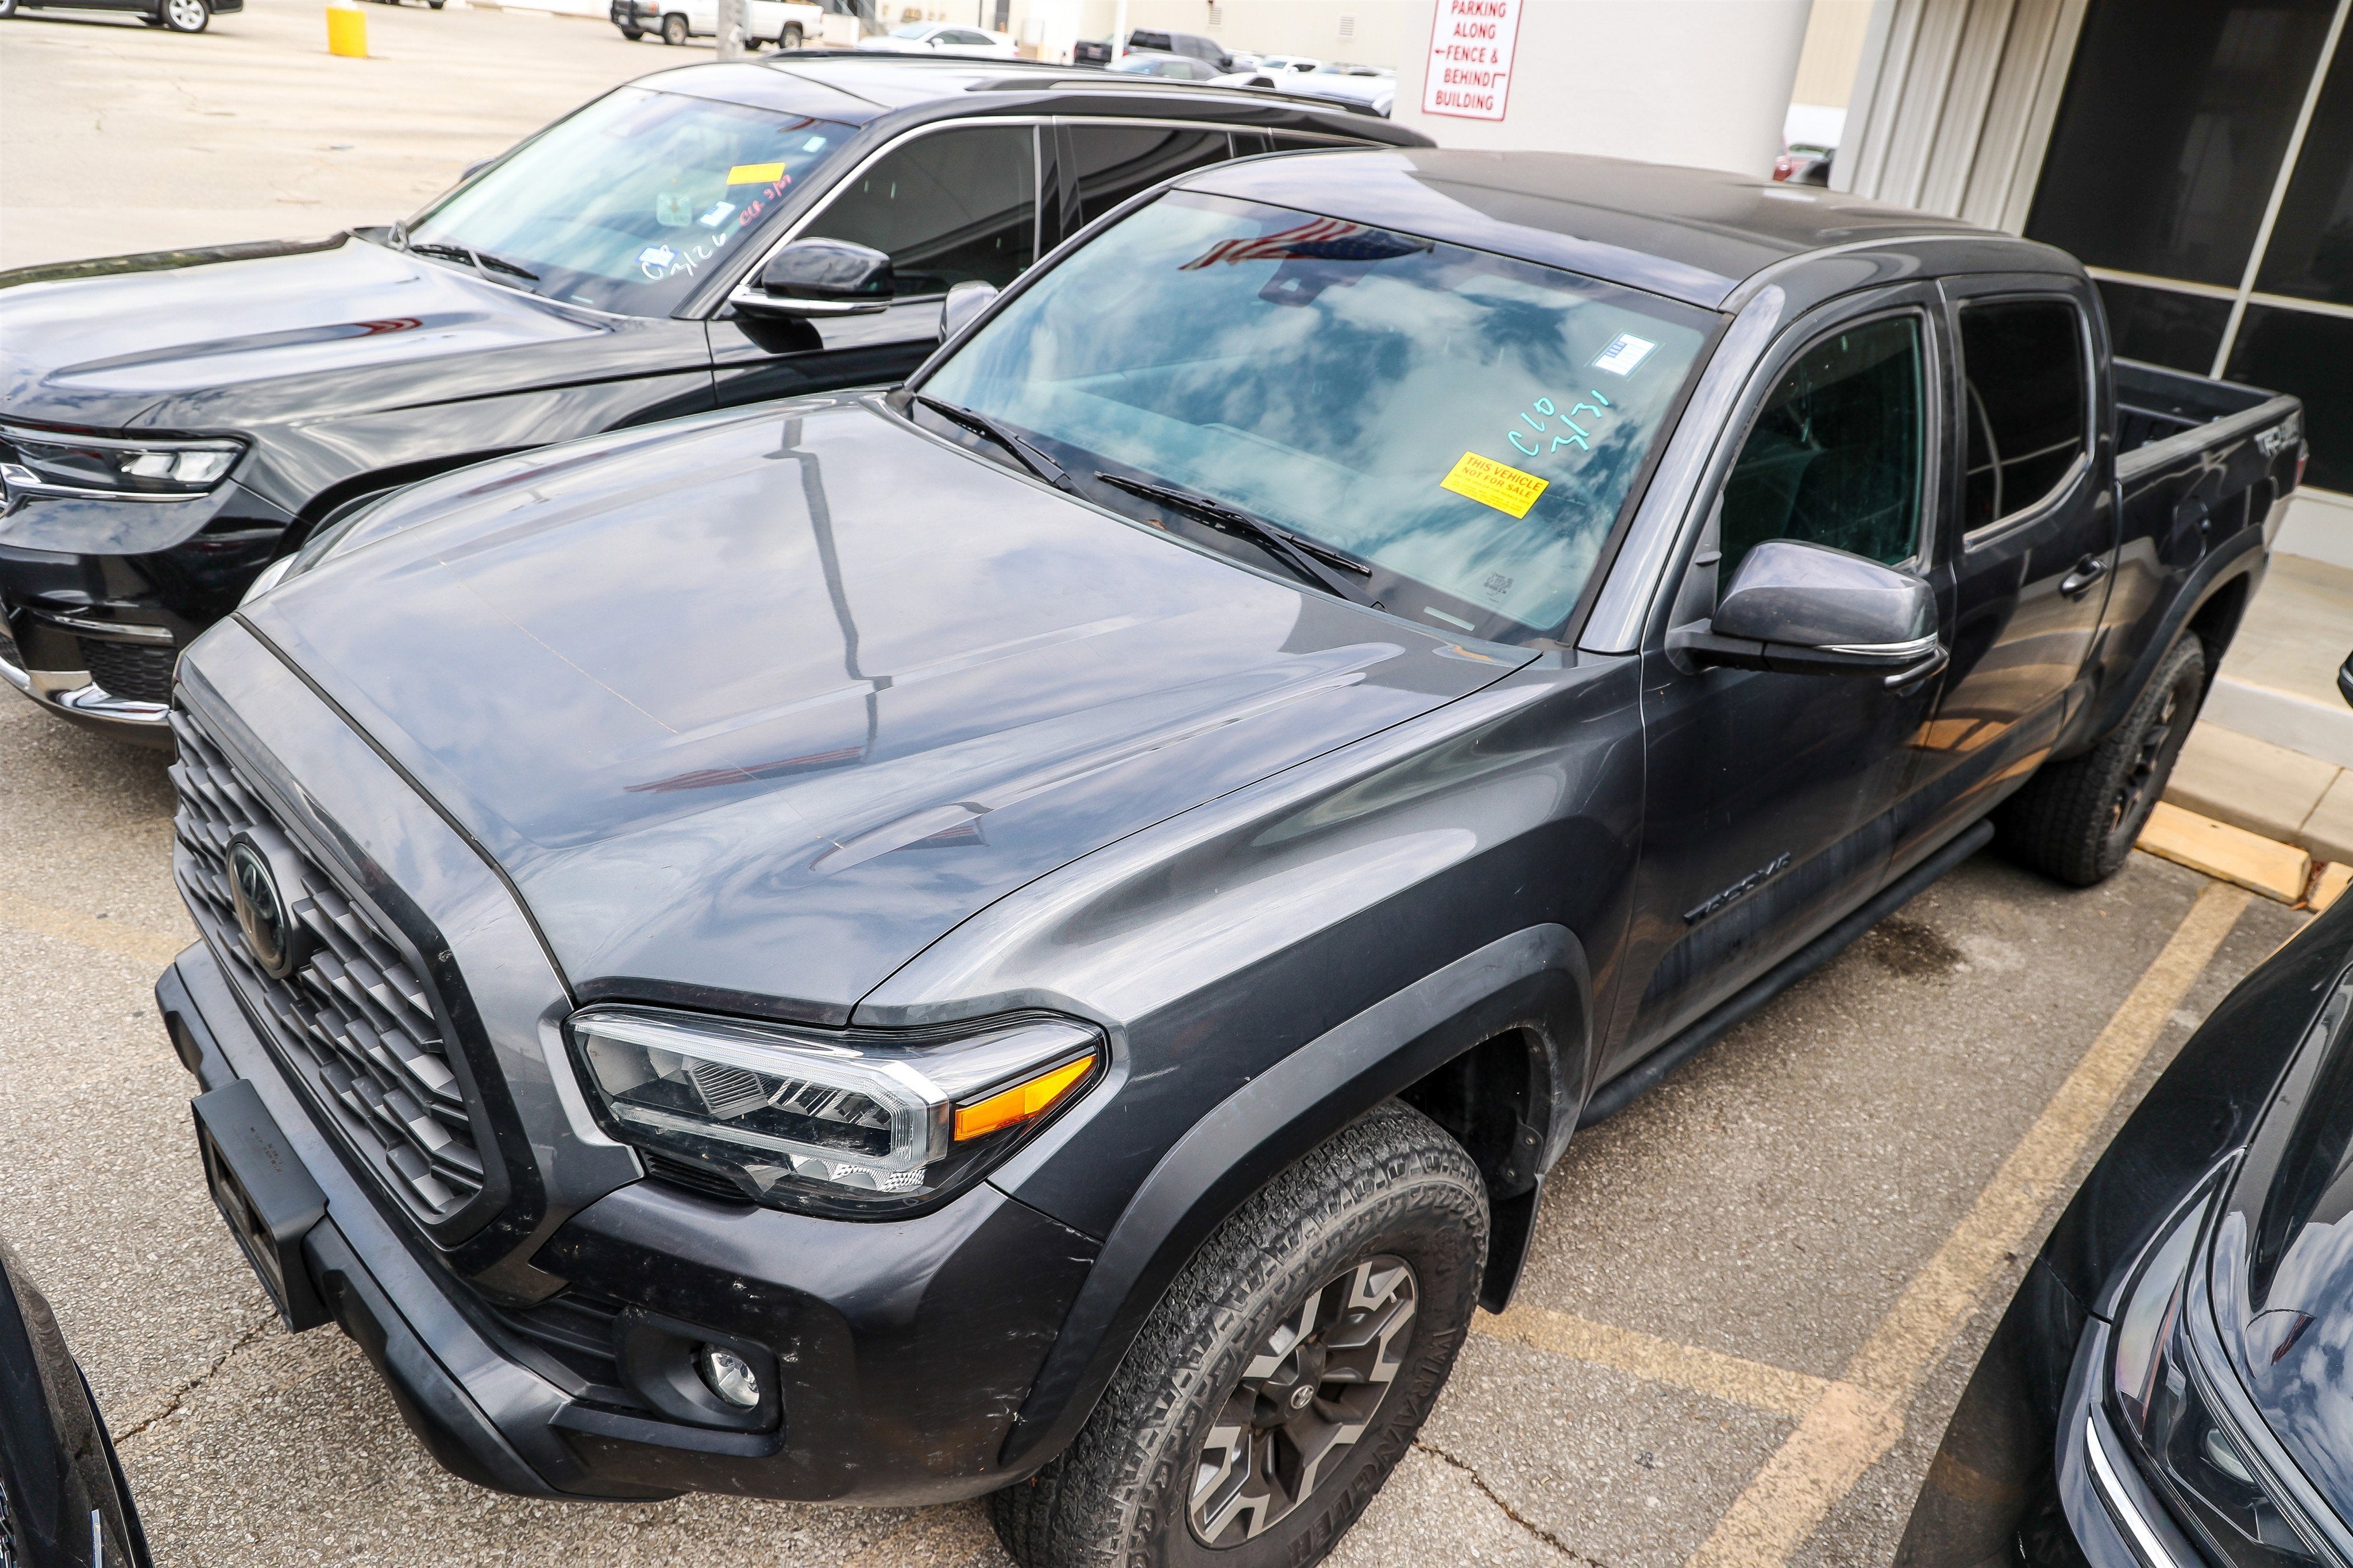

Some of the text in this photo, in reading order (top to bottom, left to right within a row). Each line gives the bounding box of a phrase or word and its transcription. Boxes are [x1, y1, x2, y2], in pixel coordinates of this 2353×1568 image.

[1451, 0, 1506, 17] PARKING
[1453, 22, 1496, 39] ALONG
[1446, 45, 1498, 63] FENCE &
[1444, 68, 1490, 86] BEHIND
[1436, 90, 1494, 110] BUILDING
[1462, 467, 1482, 478] NOT
[1483, 475, 1505, 488] FOR
[1506, 484, 1533, 499] SALE
[1467, 457, 1492, 472] THIS
[1494, 466, 1543, 491] VEHICLE
